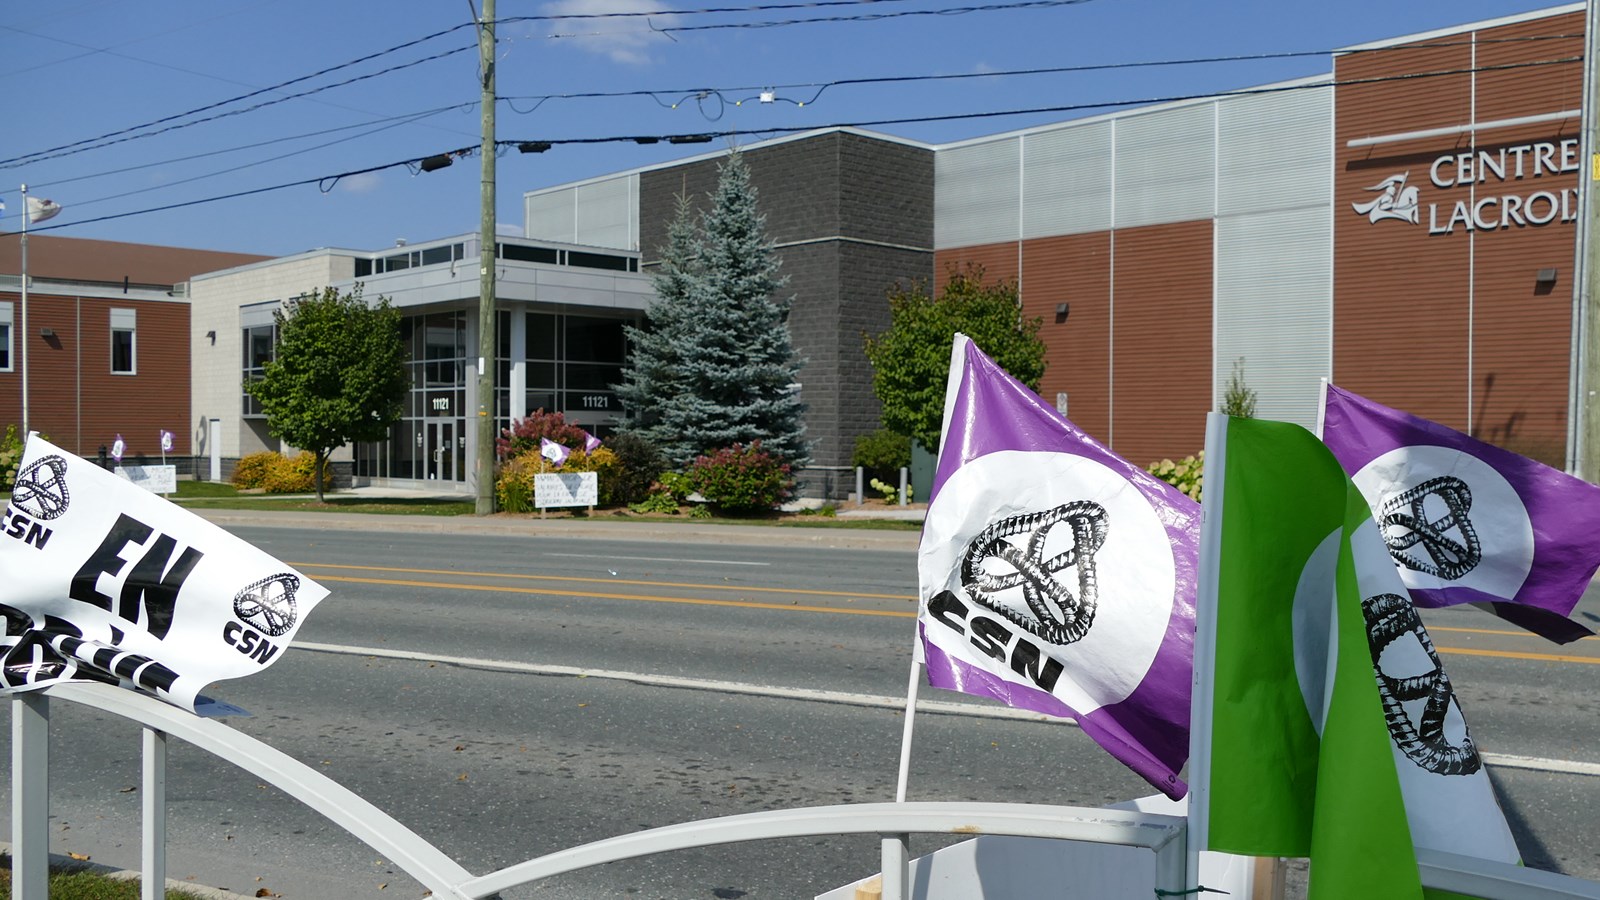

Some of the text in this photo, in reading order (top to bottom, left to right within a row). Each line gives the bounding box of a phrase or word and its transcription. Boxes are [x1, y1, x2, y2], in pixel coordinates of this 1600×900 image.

[1430, 139, 1579, 188] CENTRE
[432, 397, 449, 410] 11121
[582, 396, 608, 408] 11121
[69, 512, 205, 641] EN
[222, 620, 279, 666] CSN
[927, 589, 1065, 694] CSN
